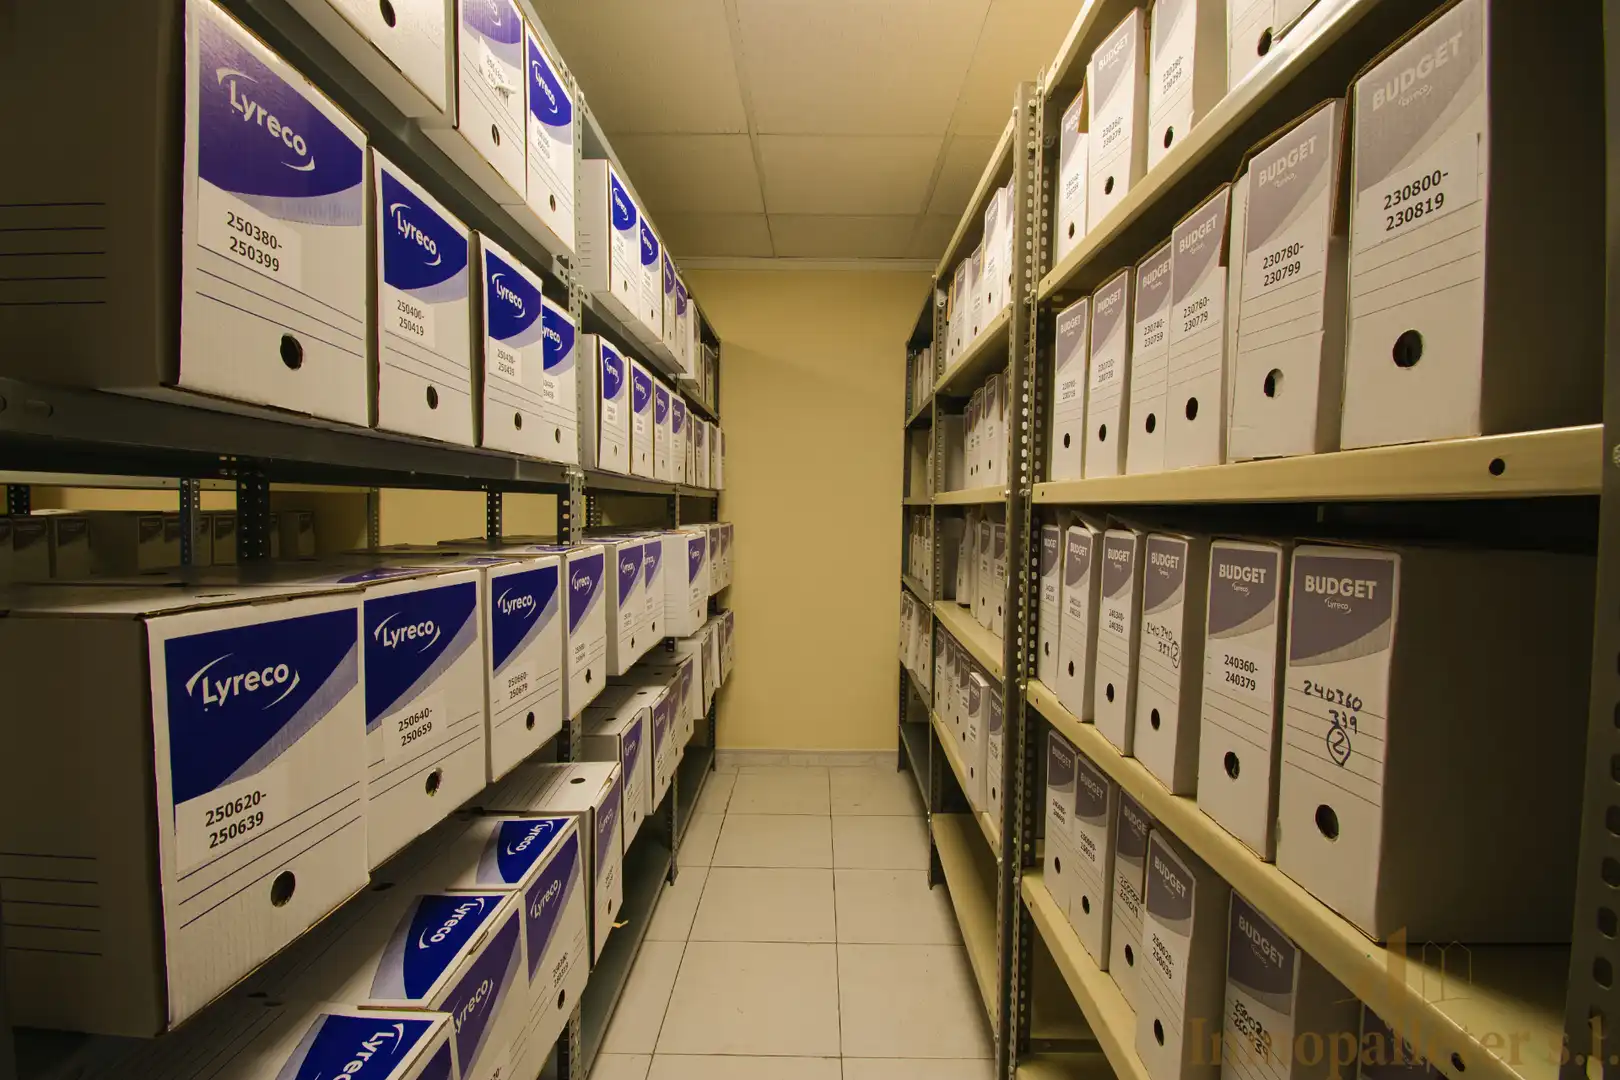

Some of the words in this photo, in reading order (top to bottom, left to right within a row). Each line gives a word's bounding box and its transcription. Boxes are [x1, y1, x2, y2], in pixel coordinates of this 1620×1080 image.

[1098, 32, 1129, 71] BUDGET
[1373, 31, 1463, 111] BUDGET
[535, 66, 556, 106] Lyreco
[228, 79, 307, 157] Lyreco
[1259, 135, 1317, 188] BUDGET
[1384, 170, 1449, 211] 230800-
[1386, 192, 1445, 231] 230819
[226, 211, 283, 250] 250380-
[397, 211, 437, 255] Lyreco
[1179, 213, 1218, 253] BUDGET
[229, 236, 280, 273] 250399
[1263, 241, 1304, 270] 230780-
[1263, 261, 1301, 287] 230799
[496, 279, 523, 309] Lyreco
[1098, 288, 1121, 313] BUDGET
[1183, 296, 1210, 318] 230760-
[399, 316, 425, 337] 250419
[1060, 315, 1081, 334] BUDGET
[1184, 311, 1209, 332] 230779
[1070, 542, 1087, 557] BUDGET
[1107, 548, 1130, 563] BUDGET
[1151, 552, 1180, 569] BUDGET
[574, 575, 591, 591] Lyreco
[1219, 564, 1266, 584] BUDGET
[1305, 575, 1377, 600] BUDGET
[502, 594, 533, 616] Lyreco
[1327, 600, 1349, 611] Lyreco
[383, 620, 434, 649] Lyreco
[1224, 654, 1258, 673] 240360-
[202, 663, 289, 707] Lyreco
[1225, 671, 1256, 690] 240379
[1303, 680, 1363, 712] 240360
[398, 707, 433, 732] 250640-
[401, 721, 433, 747] 250659
[1052, 746, 1071, 769] BUDGET
[1080, 772, 1104, 800] BUDGET
[205, 791, 267, 828] 250620-
[1123, 805, 1147, 835] BUDGE
[209, 811, 264, 849] 250639
[516, 824, 549, 851] Lyreco
[1154, 856, 1187, 897] BUDGET
[535, 880, 559, 919] Lyreco
[430, 903, 478, 943] Lyreco
[1238, 915, 1284, 969] BUDGET
[456, 980, 489, 1034] yreco
